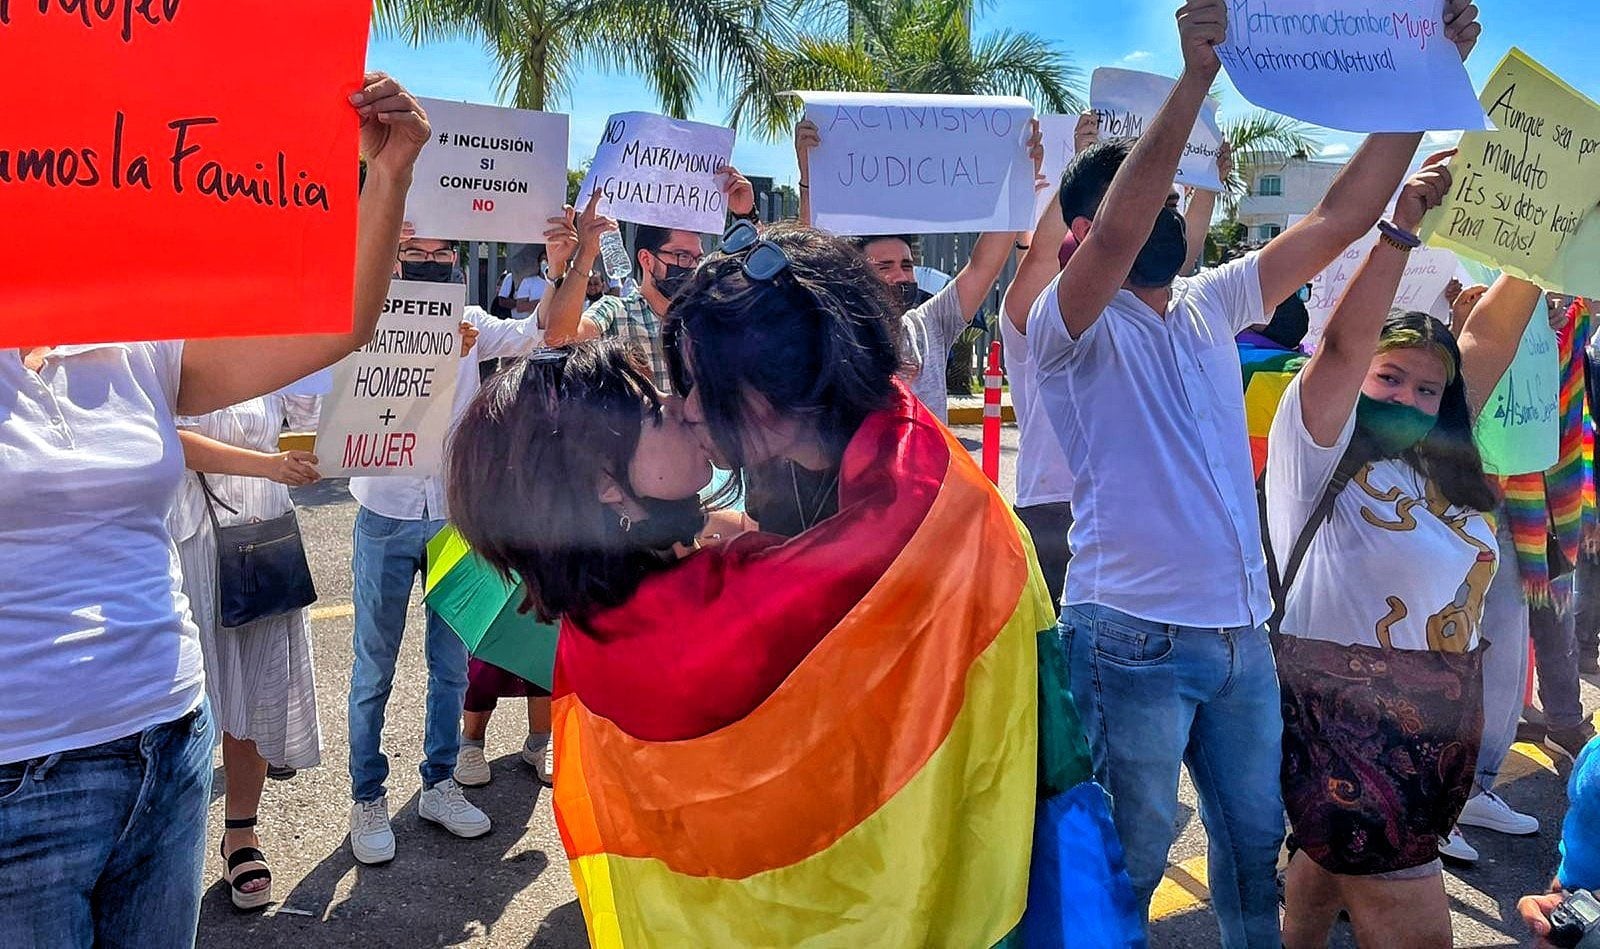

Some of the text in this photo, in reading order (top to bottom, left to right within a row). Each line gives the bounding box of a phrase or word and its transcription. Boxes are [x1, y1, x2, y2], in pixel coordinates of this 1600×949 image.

[1228, 0, 1438, 50] MatrimonioHombreMujer
[600, 120, 626, 145] NO
[829, 105, 1012, 138] ACTIVISMO
[1487, 83, 1600, 164] Aunque sea por
[453, 133, 534, 153] INCLUSIÓN
[622, 140, 726, 174] MATRIMONIO
[113, 111, 152, 190] la
[168, 117, 329, 211] Familia
[480, 158, 495, 171] SI
[838, 152, 997, 187] JUDICIAL
[1483, 141, 1548, 190] mandato
[439, 176, 529, 194] CONFUSIÓN
[587, 175, 721, 213] IGUALITARIO
[472, 199, 495, 213] NO
[1450, 207, 1485, 238] Para
[1491, 192, 1512, 212] su
[1514, 192, 1548, 226] deber
[364, 329, 454, 356] MATRIMONIO
[354, 367, 435, 398] HOMBRE
[342, 433, 417, 468] MUJER
